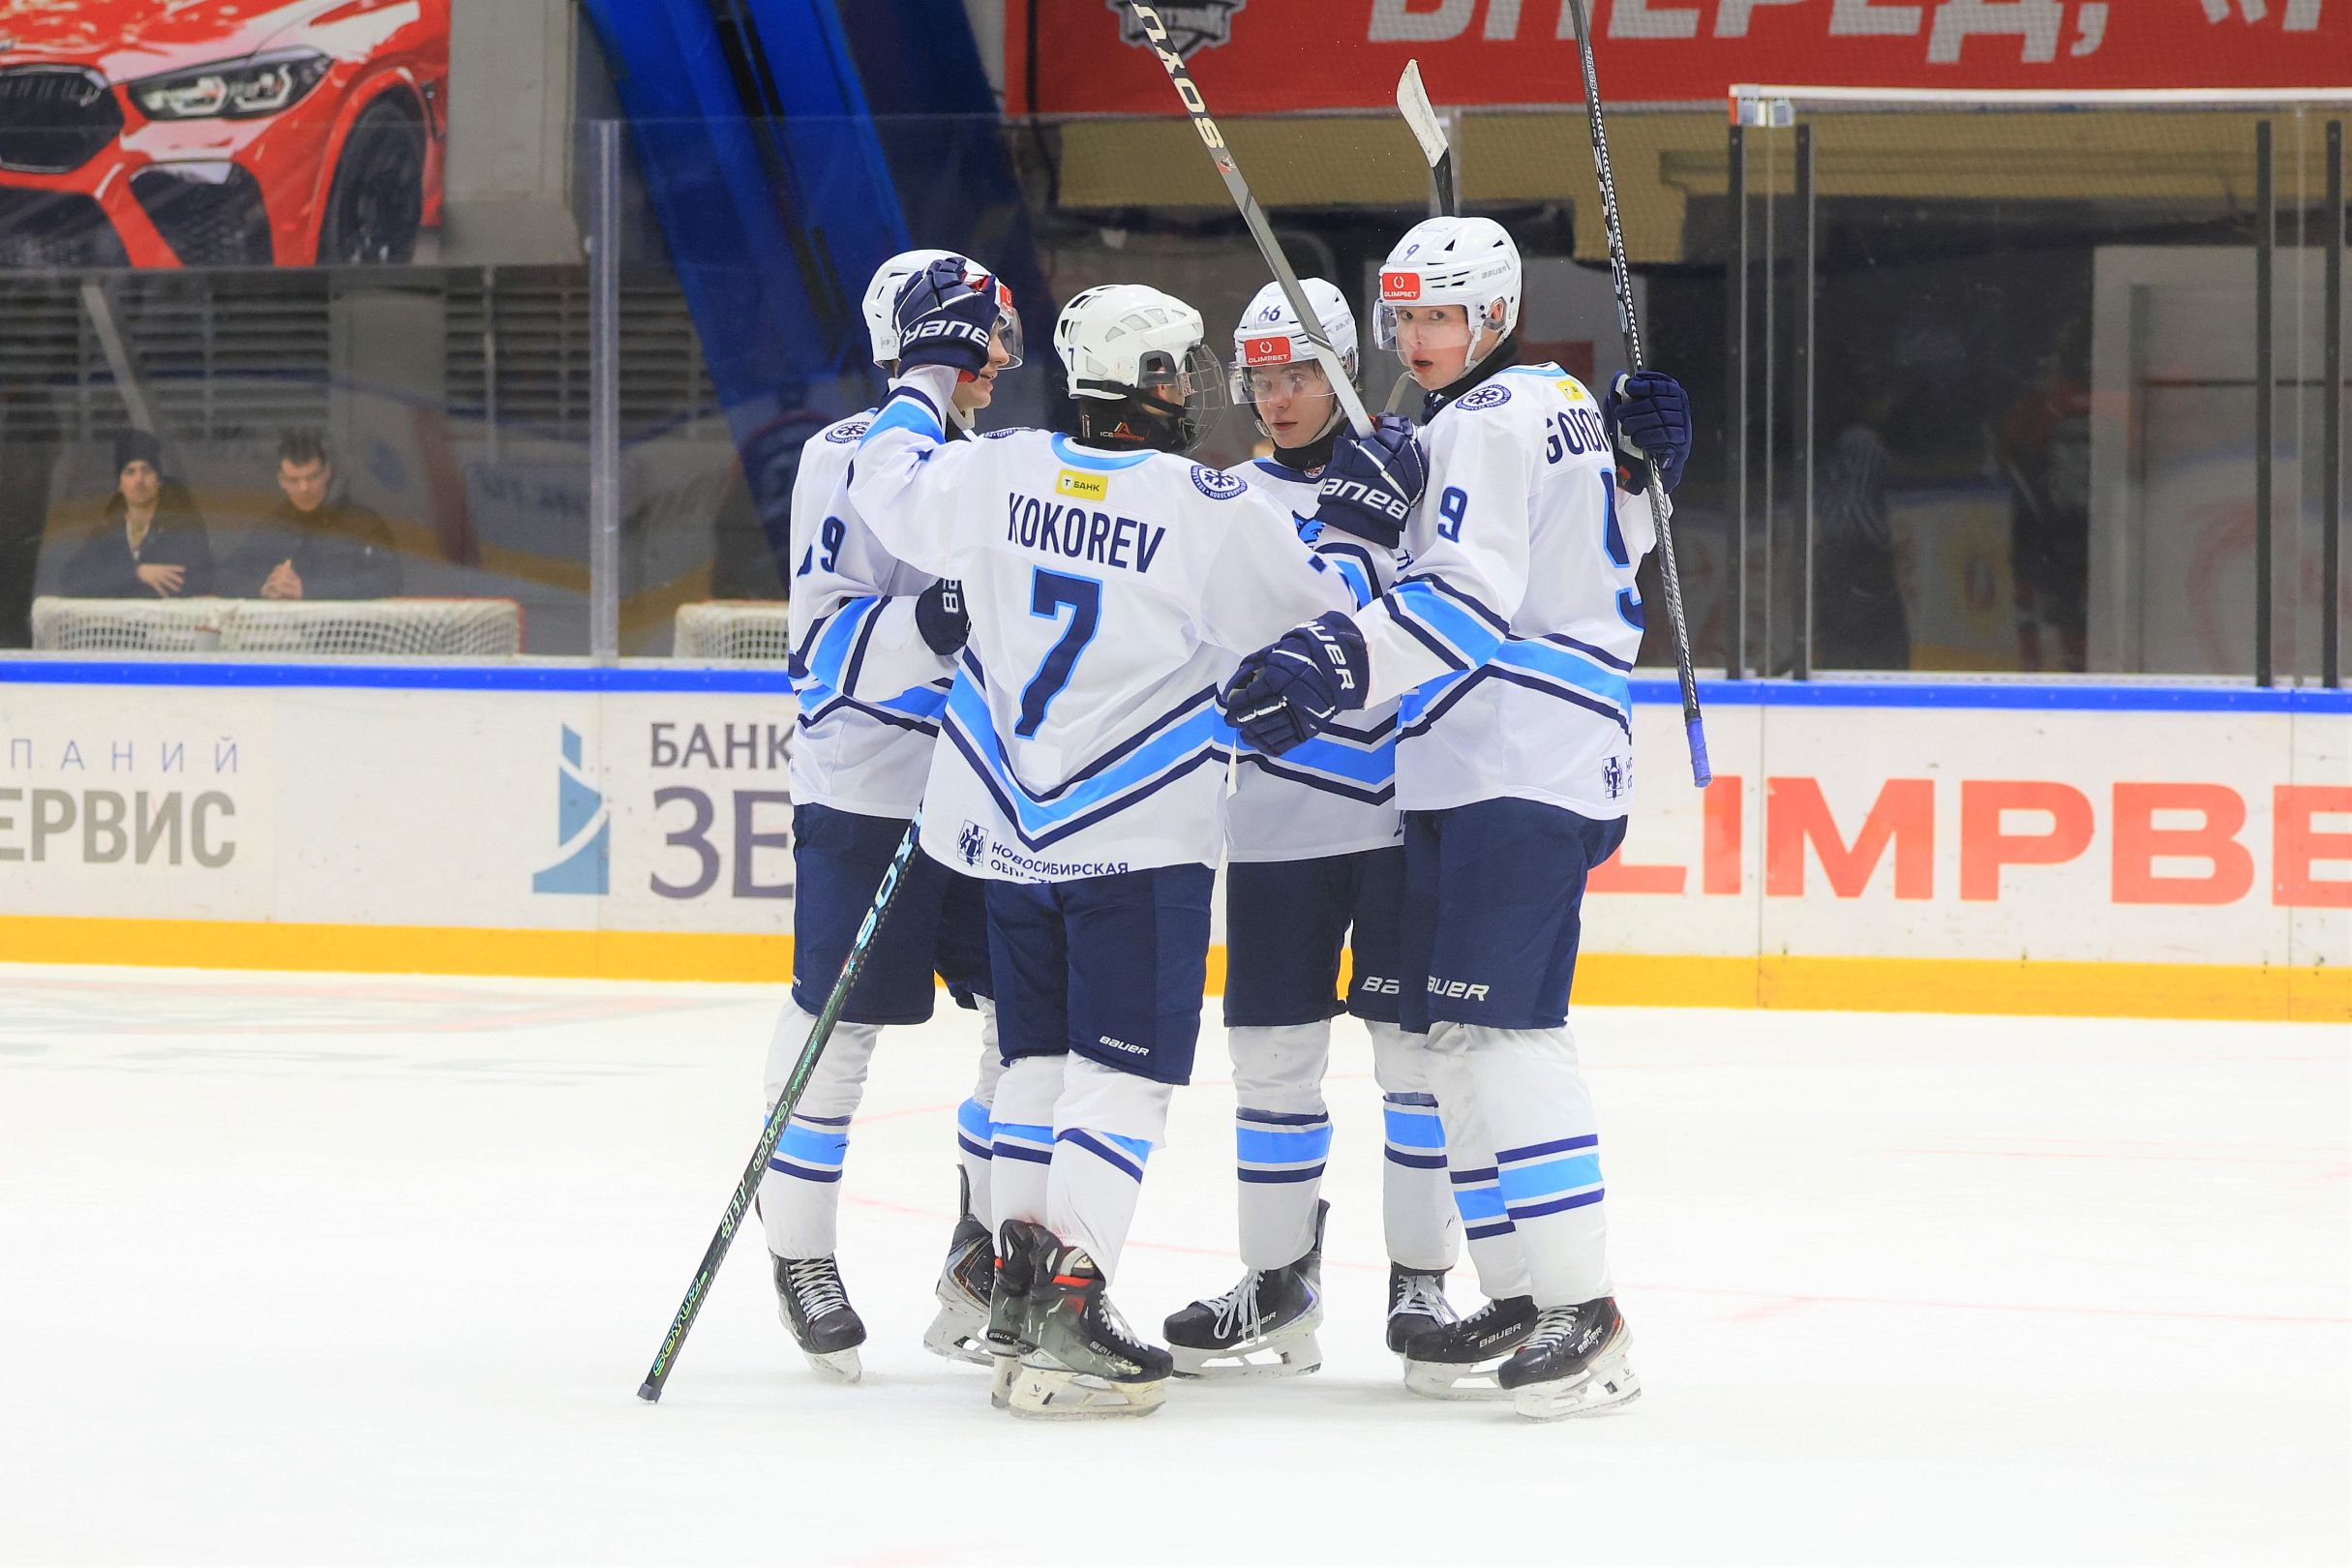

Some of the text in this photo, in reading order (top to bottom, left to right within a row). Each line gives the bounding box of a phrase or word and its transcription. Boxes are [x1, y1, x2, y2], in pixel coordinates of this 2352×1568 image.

[1403, 244, 1420, 260] 9
[1257, 305, 1282, 322] 66
[1068, 347, 1074, 372] 7
[1248, 353, 1288, 364] OLIMPBET
[1072, 482, 1101, 493] БАНК
[1321, 477, 1409, 520] BAUE
[1437, 485, 1468, 543] 9
[1008, 492, 1166, 574] KOKOREV
[1014, 563, 1103, 740] 7
[11, 736, 238, 774] ПАНИЙ
[651, 723, 796, 769] БАНК
[650, 786, 795, 899] ЗЕ
[991, 841, 1129, 876] НОВОСИБИРСКАЯ
[1100, 1036, 1150, 1056] BAUER
[1479, 1322, 1523, 1348] BAUER
